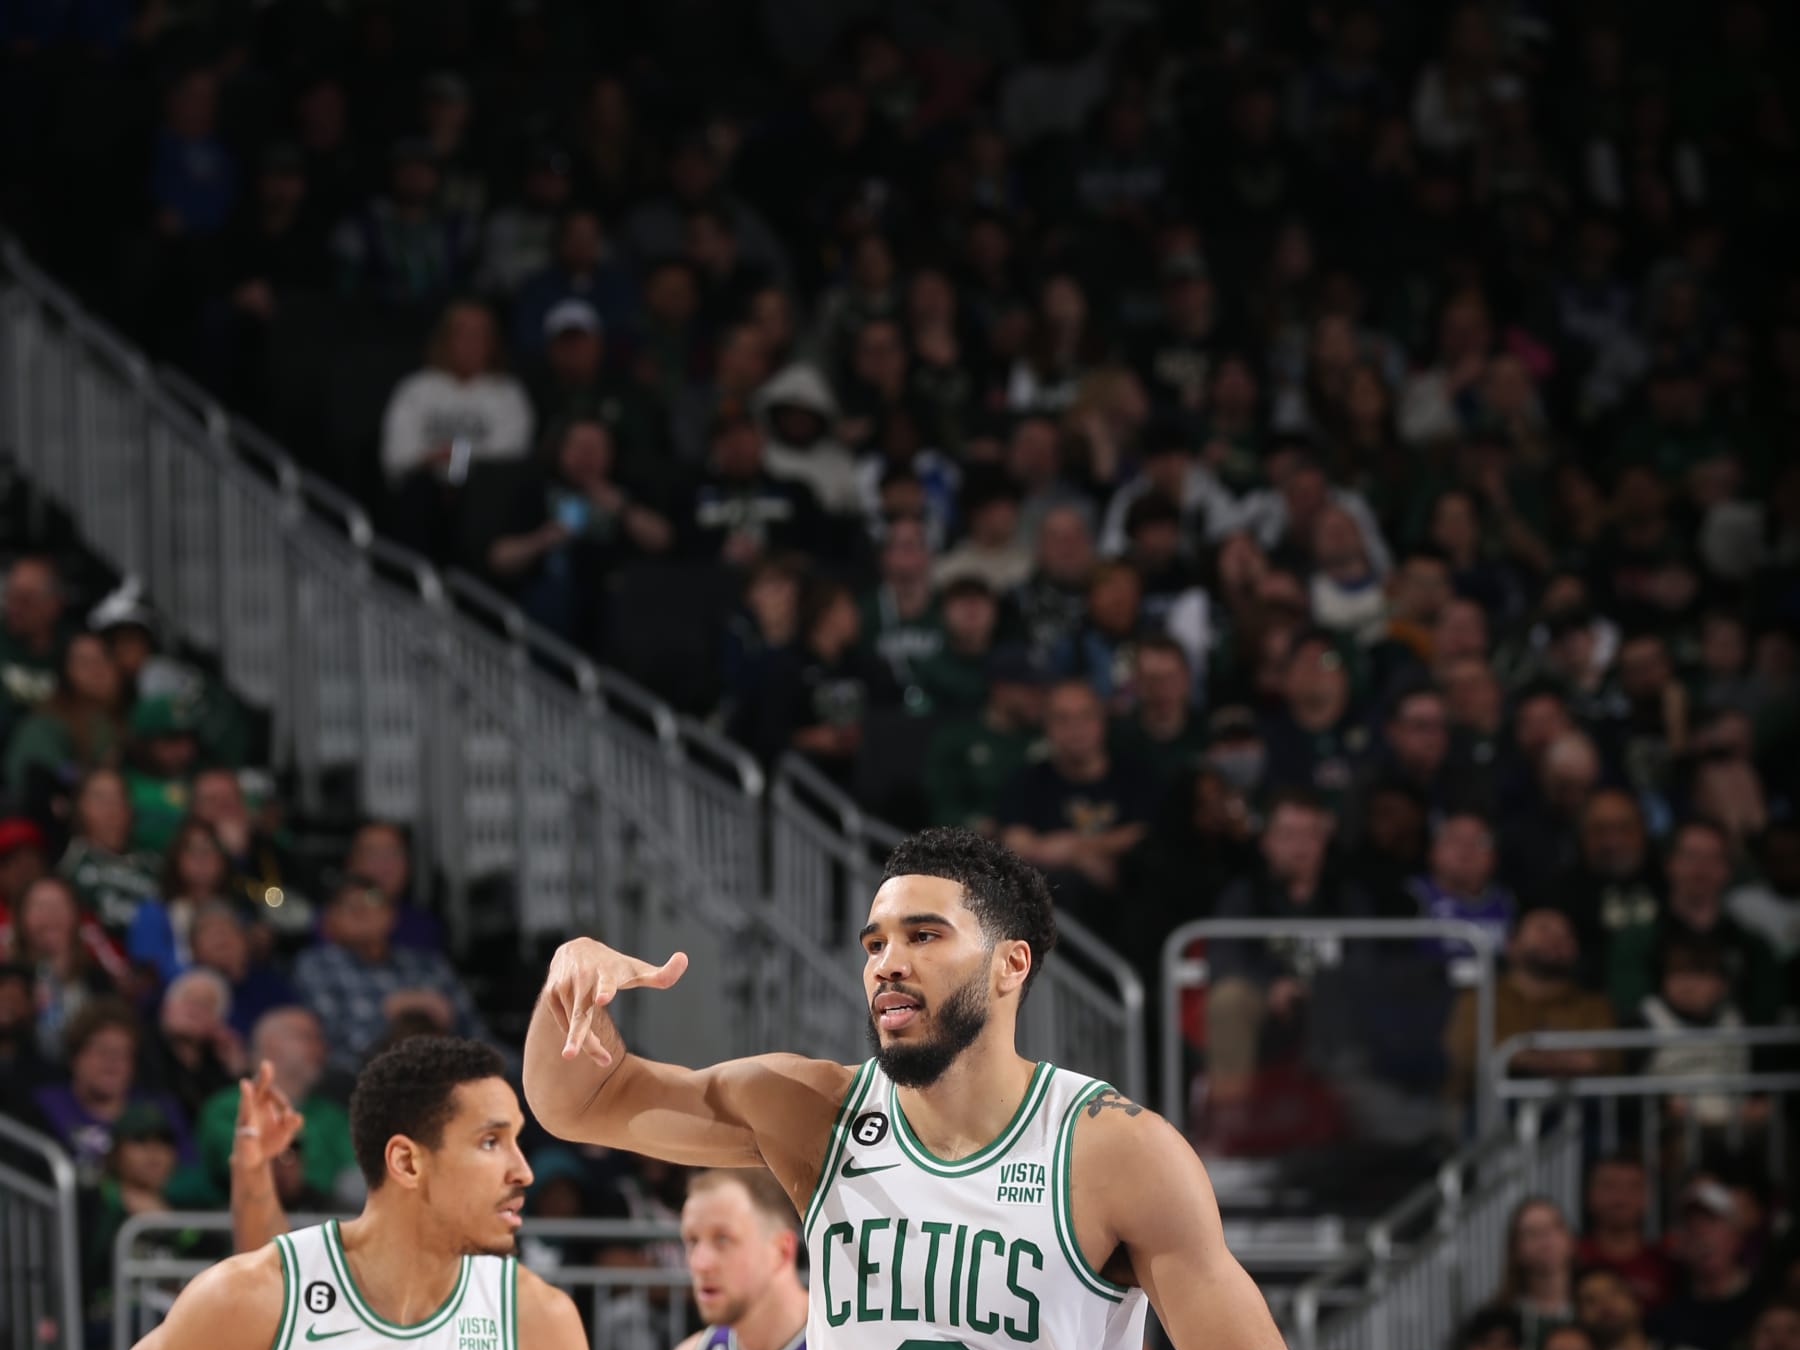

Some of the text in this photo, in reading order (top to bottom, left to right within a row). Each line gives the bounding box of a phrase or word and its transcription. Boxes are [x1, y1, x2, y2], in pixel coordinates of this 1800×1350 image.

[859, 1117, 882, 1142] 6
[1000, 1163, 1045, 1186] VISTA
[997, 1186, 1045, 1203] PRINT
[823, 1217, 1043, 1343] CELTICS
[310, 1285, 329, 1310] 6
[459, 1317, 498, 1336] VISTA
